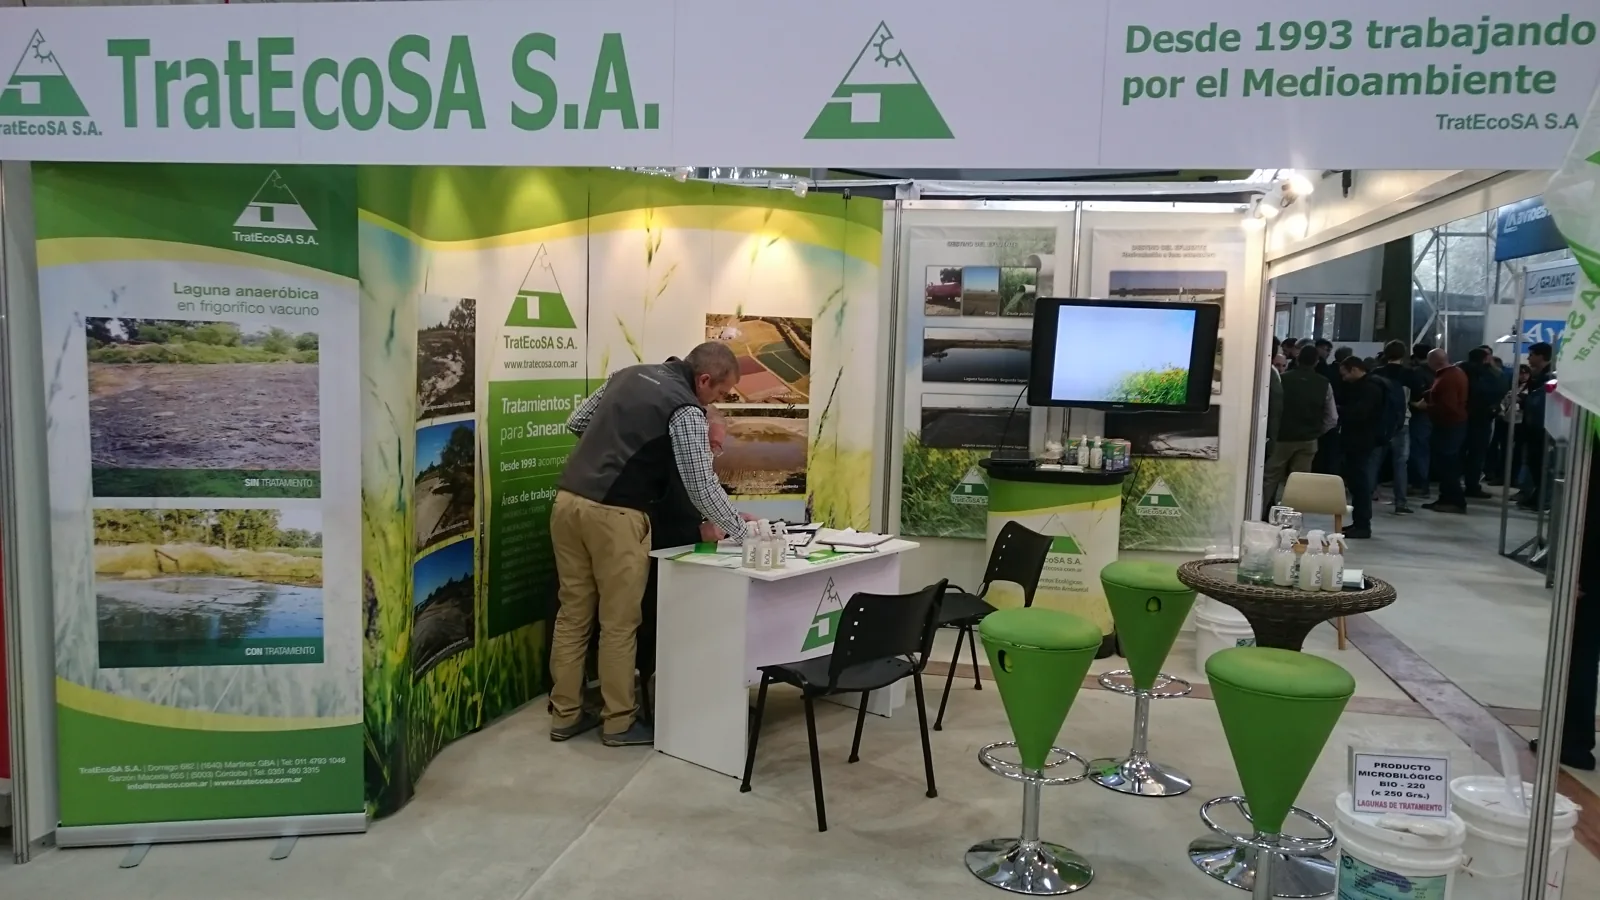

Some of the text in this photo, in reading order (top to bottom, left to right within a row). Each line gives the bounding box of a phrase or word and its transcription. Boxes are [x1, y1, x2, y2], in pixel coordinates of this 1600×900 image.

[1125, 14, 1597, 55] Desde 1993 trabajando
[107, 32, 660, 131] TratEcoSA S.A.
[1121, 64, 1557, 106] por el Medioambiente
[72, 120, 103, 136] S.A.
[1435, 114, 1539, 131] TratEcoSA
[232, 231, 319, 246] TratEcoSA S.A.
[1541, 271, 1576, 288] GRANTEC
[173, 281, 319, 300] Laguna anaeróbica
[177, 300, 319, 316] en frigorífico vacuno
[503, 335, 578, 350] TratEcoSA S.A.
[504, 359, 578, 369] www.tratecosa.com.ar
[501, 394, 571, 414] Tratamientos
[500, 420, 573, 445] para Saneam
[500, 459, 519, 472] Desde
[521, 458, 537, 469] 1993
[244, 478, 313, 488] SIN TRATAMIENTO
[501, 486, 557, 507] Áreas de trabajo
[245, 646, 315, 656] CON TRATAMIENTO
[1373, 762, 1431, 772] PRODUCTO
[1358, 770, 1443, 781] MICROBILÓGICO
[1379, 780, 1397, 788] BIO
[1371, 789, 1430, 800] (x 250 Grs.)
[1357, 800, 1443, 812] LAGUNAS DE TRATAMIENTO
